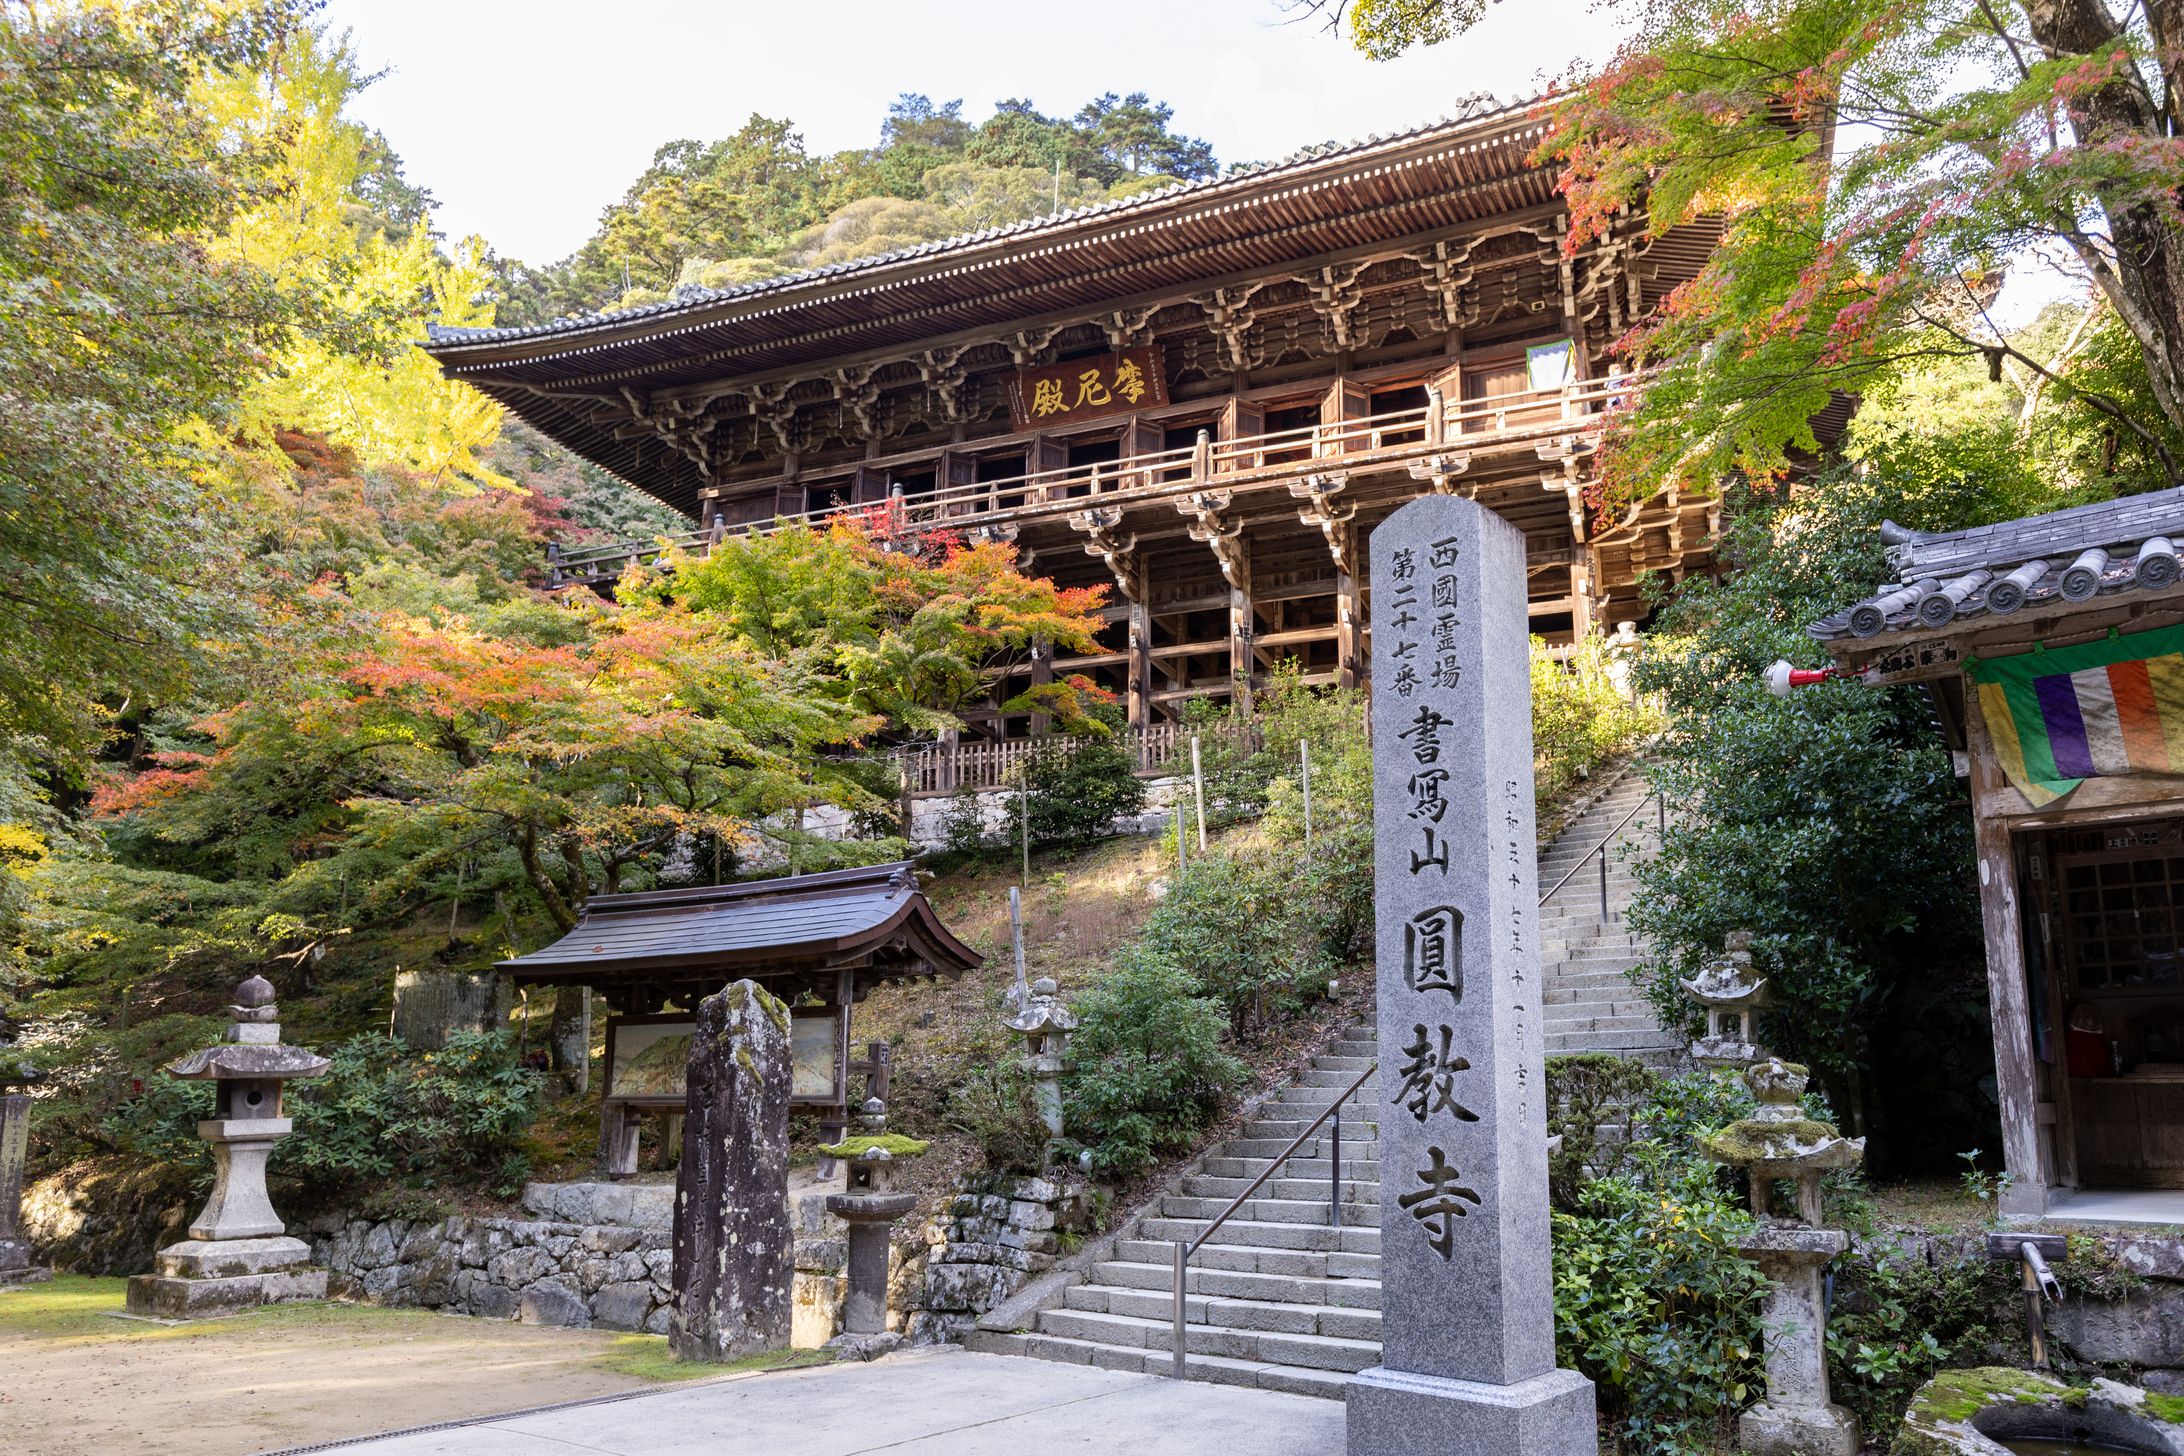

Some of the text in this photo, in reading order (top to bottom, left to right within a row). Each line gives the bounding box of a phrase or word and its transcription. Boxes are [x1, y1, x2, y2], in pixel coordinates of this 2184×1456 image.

[1388, 547, 1423, 698] 第二十七番
[1390, 704, 1482, 1263] 書寫山圓教寺
